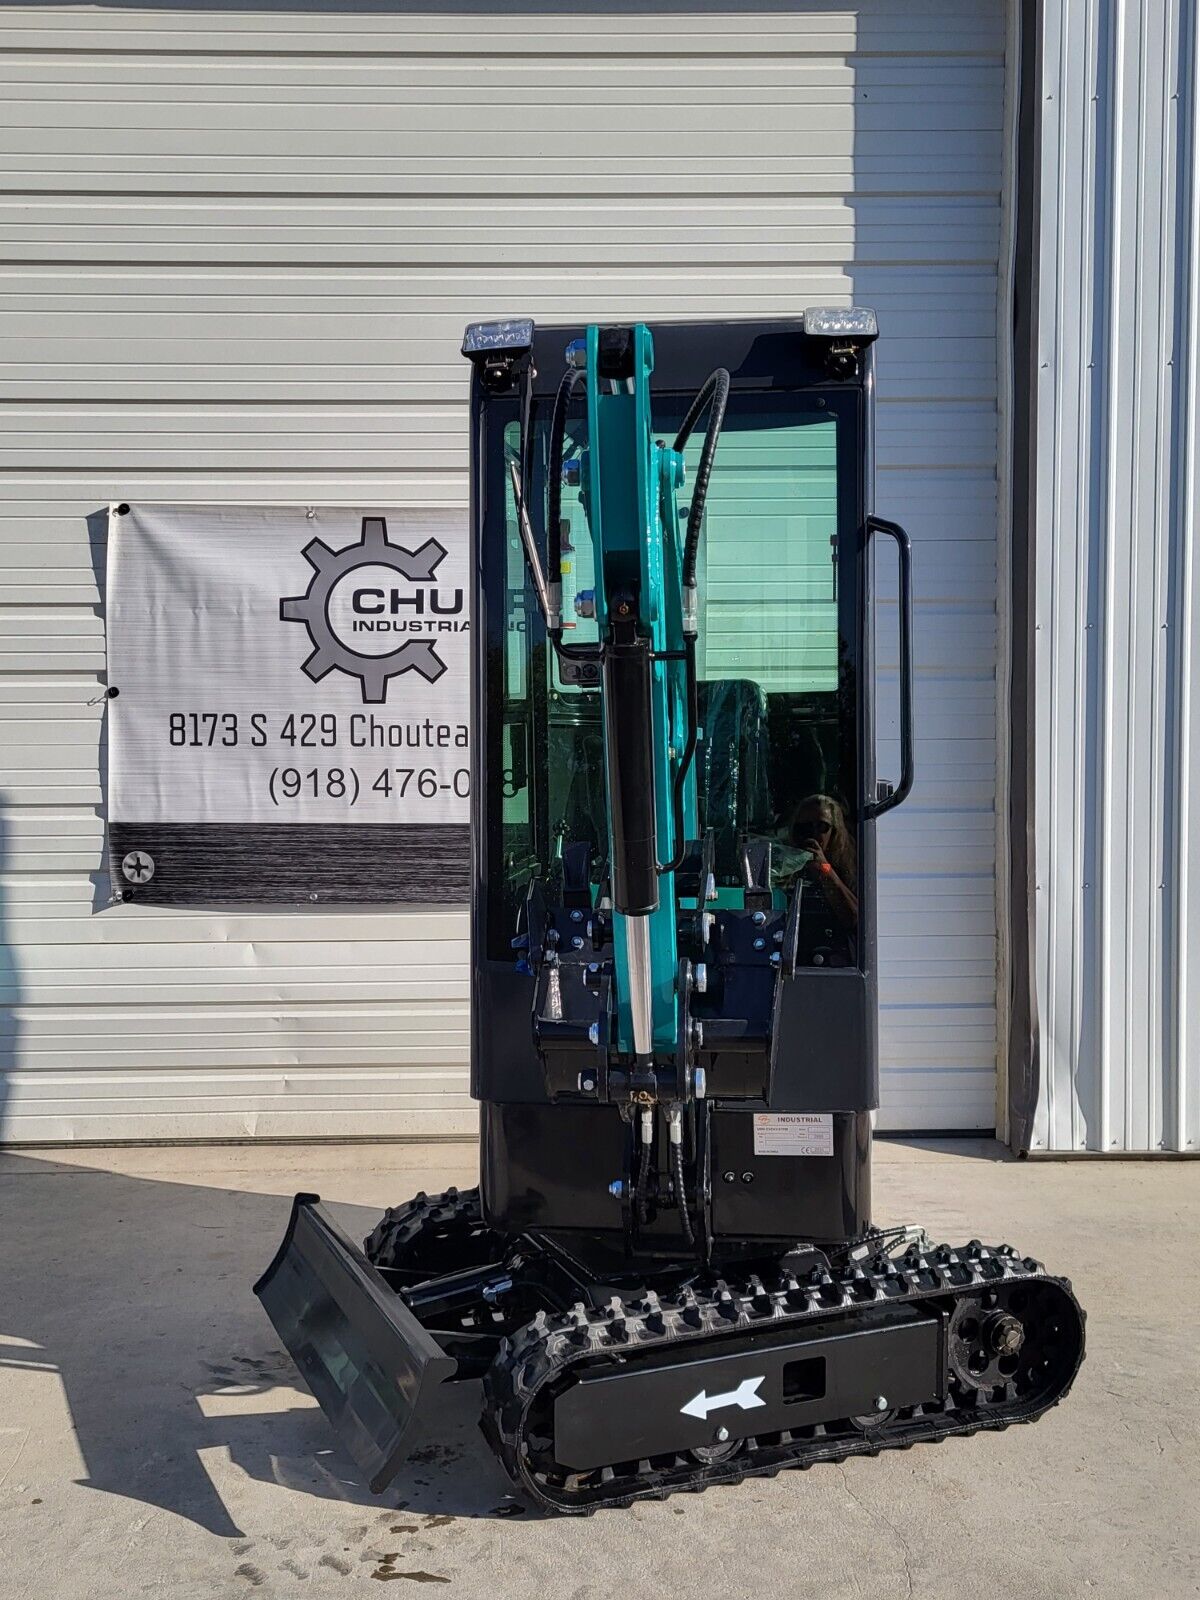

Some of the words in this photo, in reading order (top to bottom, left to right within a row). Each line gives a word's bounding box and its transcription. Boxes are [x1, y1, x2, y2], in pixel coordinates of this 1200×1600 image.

[352, 588, 463, 615] CHU
[169, 712, 238, 747] 8173
[250, 713, 267, 747] S
[280, 713, 337, 747] 429
[350, 713, 469, 748] Choutea
[269, 767, 360, 806] (918)
